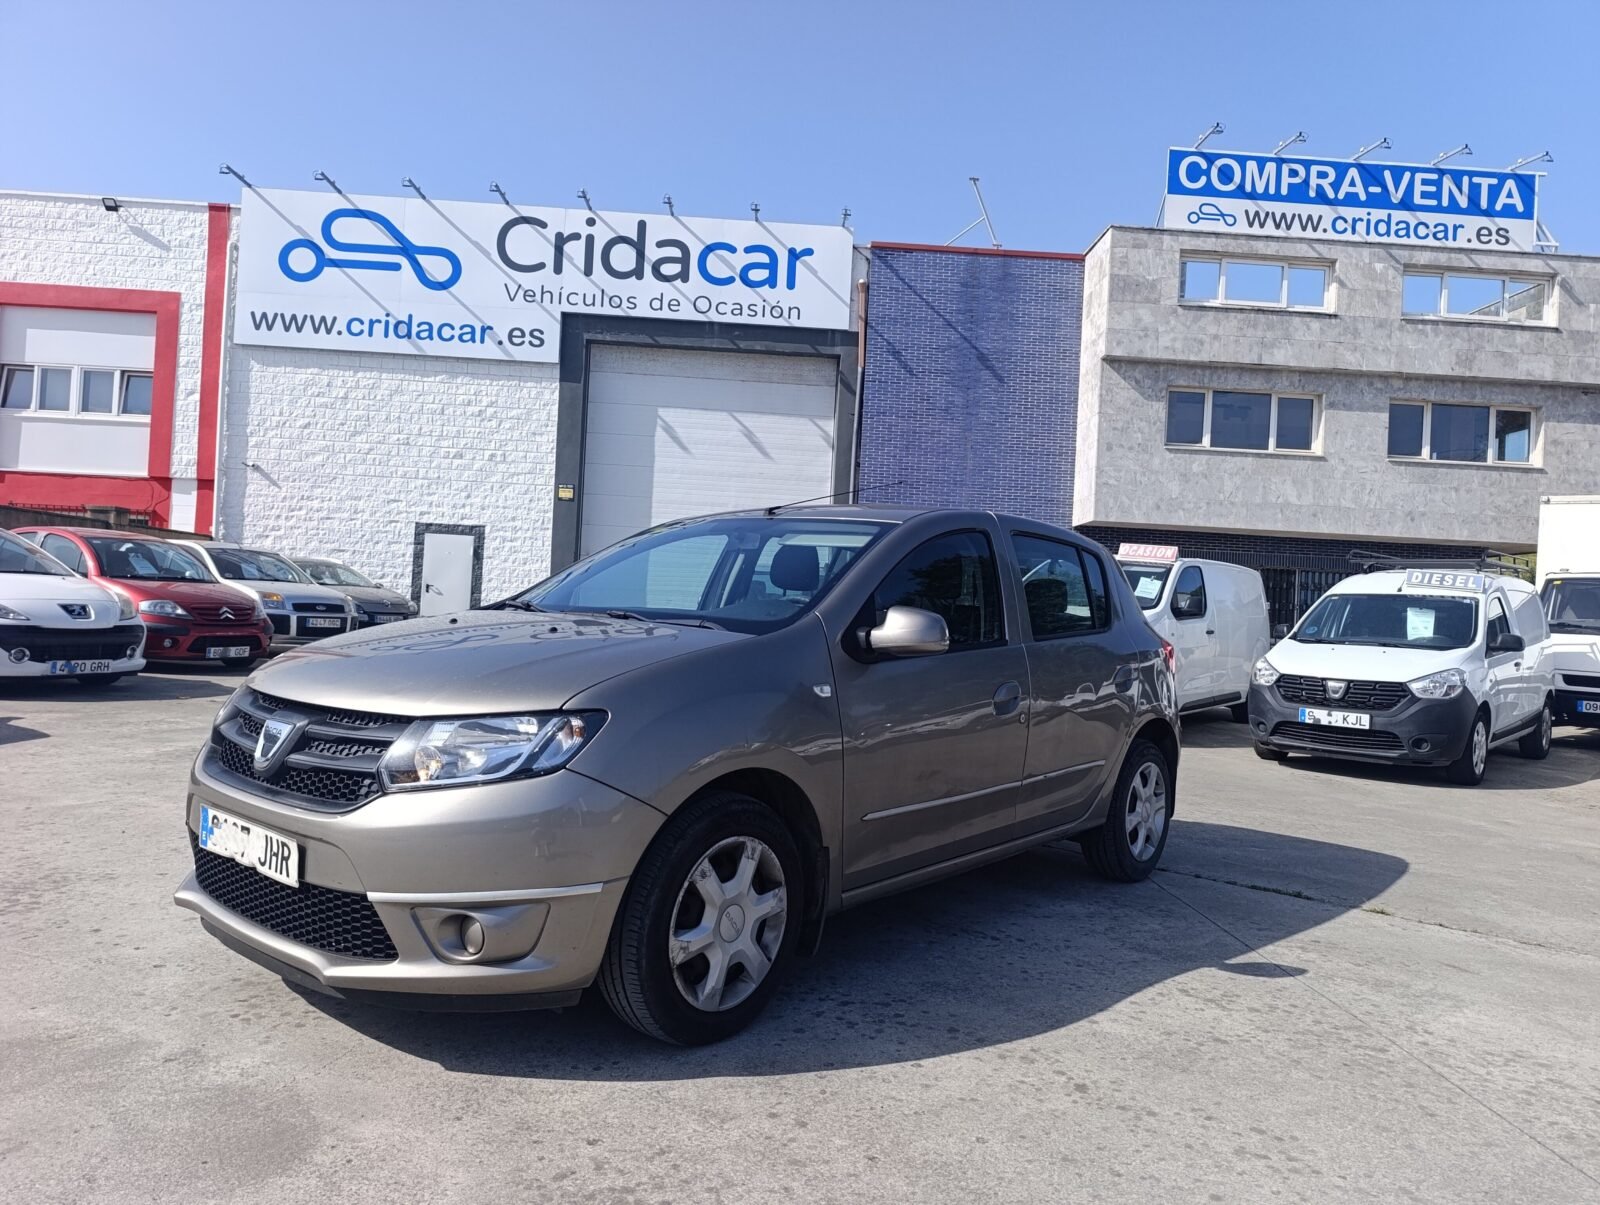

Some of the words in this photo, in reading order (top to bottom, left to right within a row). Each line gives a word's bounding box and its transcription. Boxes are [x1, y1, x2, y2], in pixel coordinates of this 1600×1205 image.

[1178, 155, 1524, 213] COMPRA-VENTA
[1243, 208, 1511, 246] www.cridacar.es
[496, 215, 815, 291] Cridacar
[504, 282, 638, 310] Vehículos
[649, 292, 681, 312] de
[693, 295, 802, 321] Ocasión
[250, 310, 546, 348] www.cridacar.es
[1410, 572, 1477, 588] DIESEL
[90, 661, 110, 672] GRH
[1342, 714, 1367, 727] KJL
[1585, 702, 1600, 713] 09
[258, 834, 292, 879] JHR
